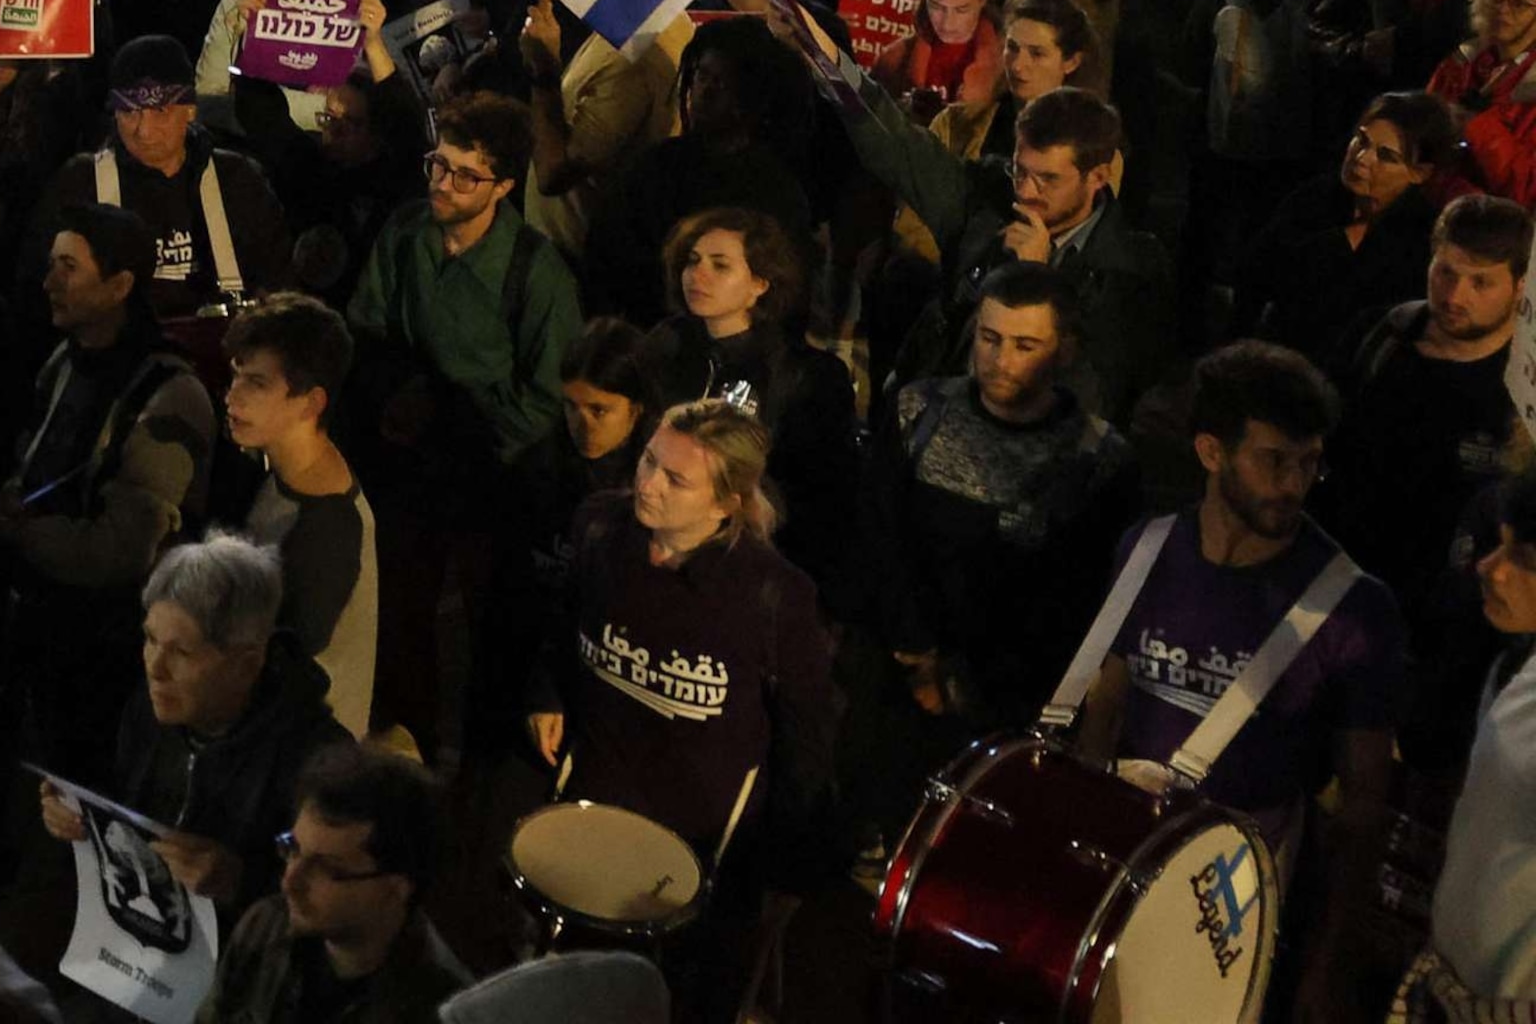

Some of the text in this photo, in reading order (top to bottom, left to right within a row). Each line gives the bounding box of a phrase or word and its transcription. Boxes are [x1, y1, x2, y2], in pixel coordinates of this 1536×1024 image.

[261, 12, 358, 42] של כולנו
[659, 648, 730, 686] نقف
[630, 663, 728, 707] עומדים
[98, 947, 134, 978] Storm
